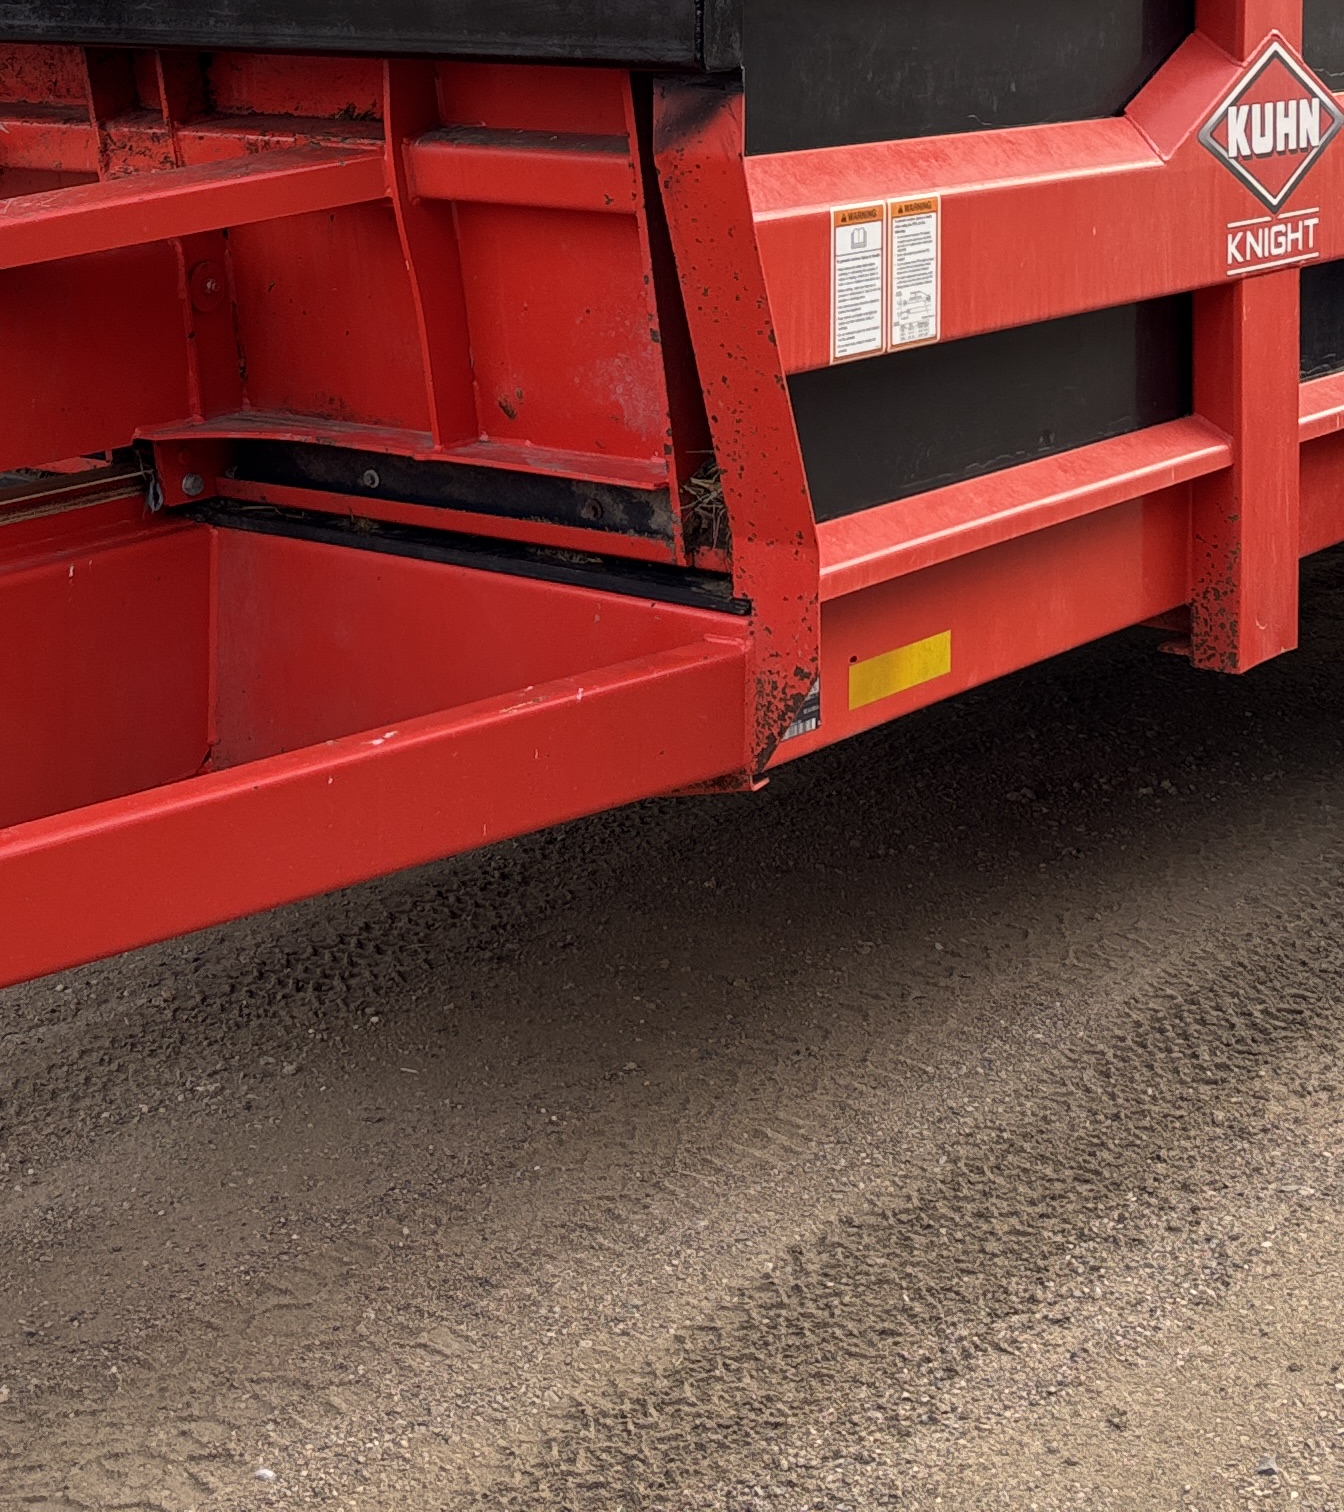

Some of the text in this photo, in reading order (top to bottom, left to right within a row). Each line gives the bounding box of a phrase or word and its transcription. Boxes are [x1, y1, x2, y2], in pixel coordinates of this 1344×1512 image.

[1227, 97, 1320, 160] KUHN
[847, 209, 878, 222] WARNING
[904, 199, 933, 213] WARNING
[1227, 217, 1319, 265] KNIGHT
